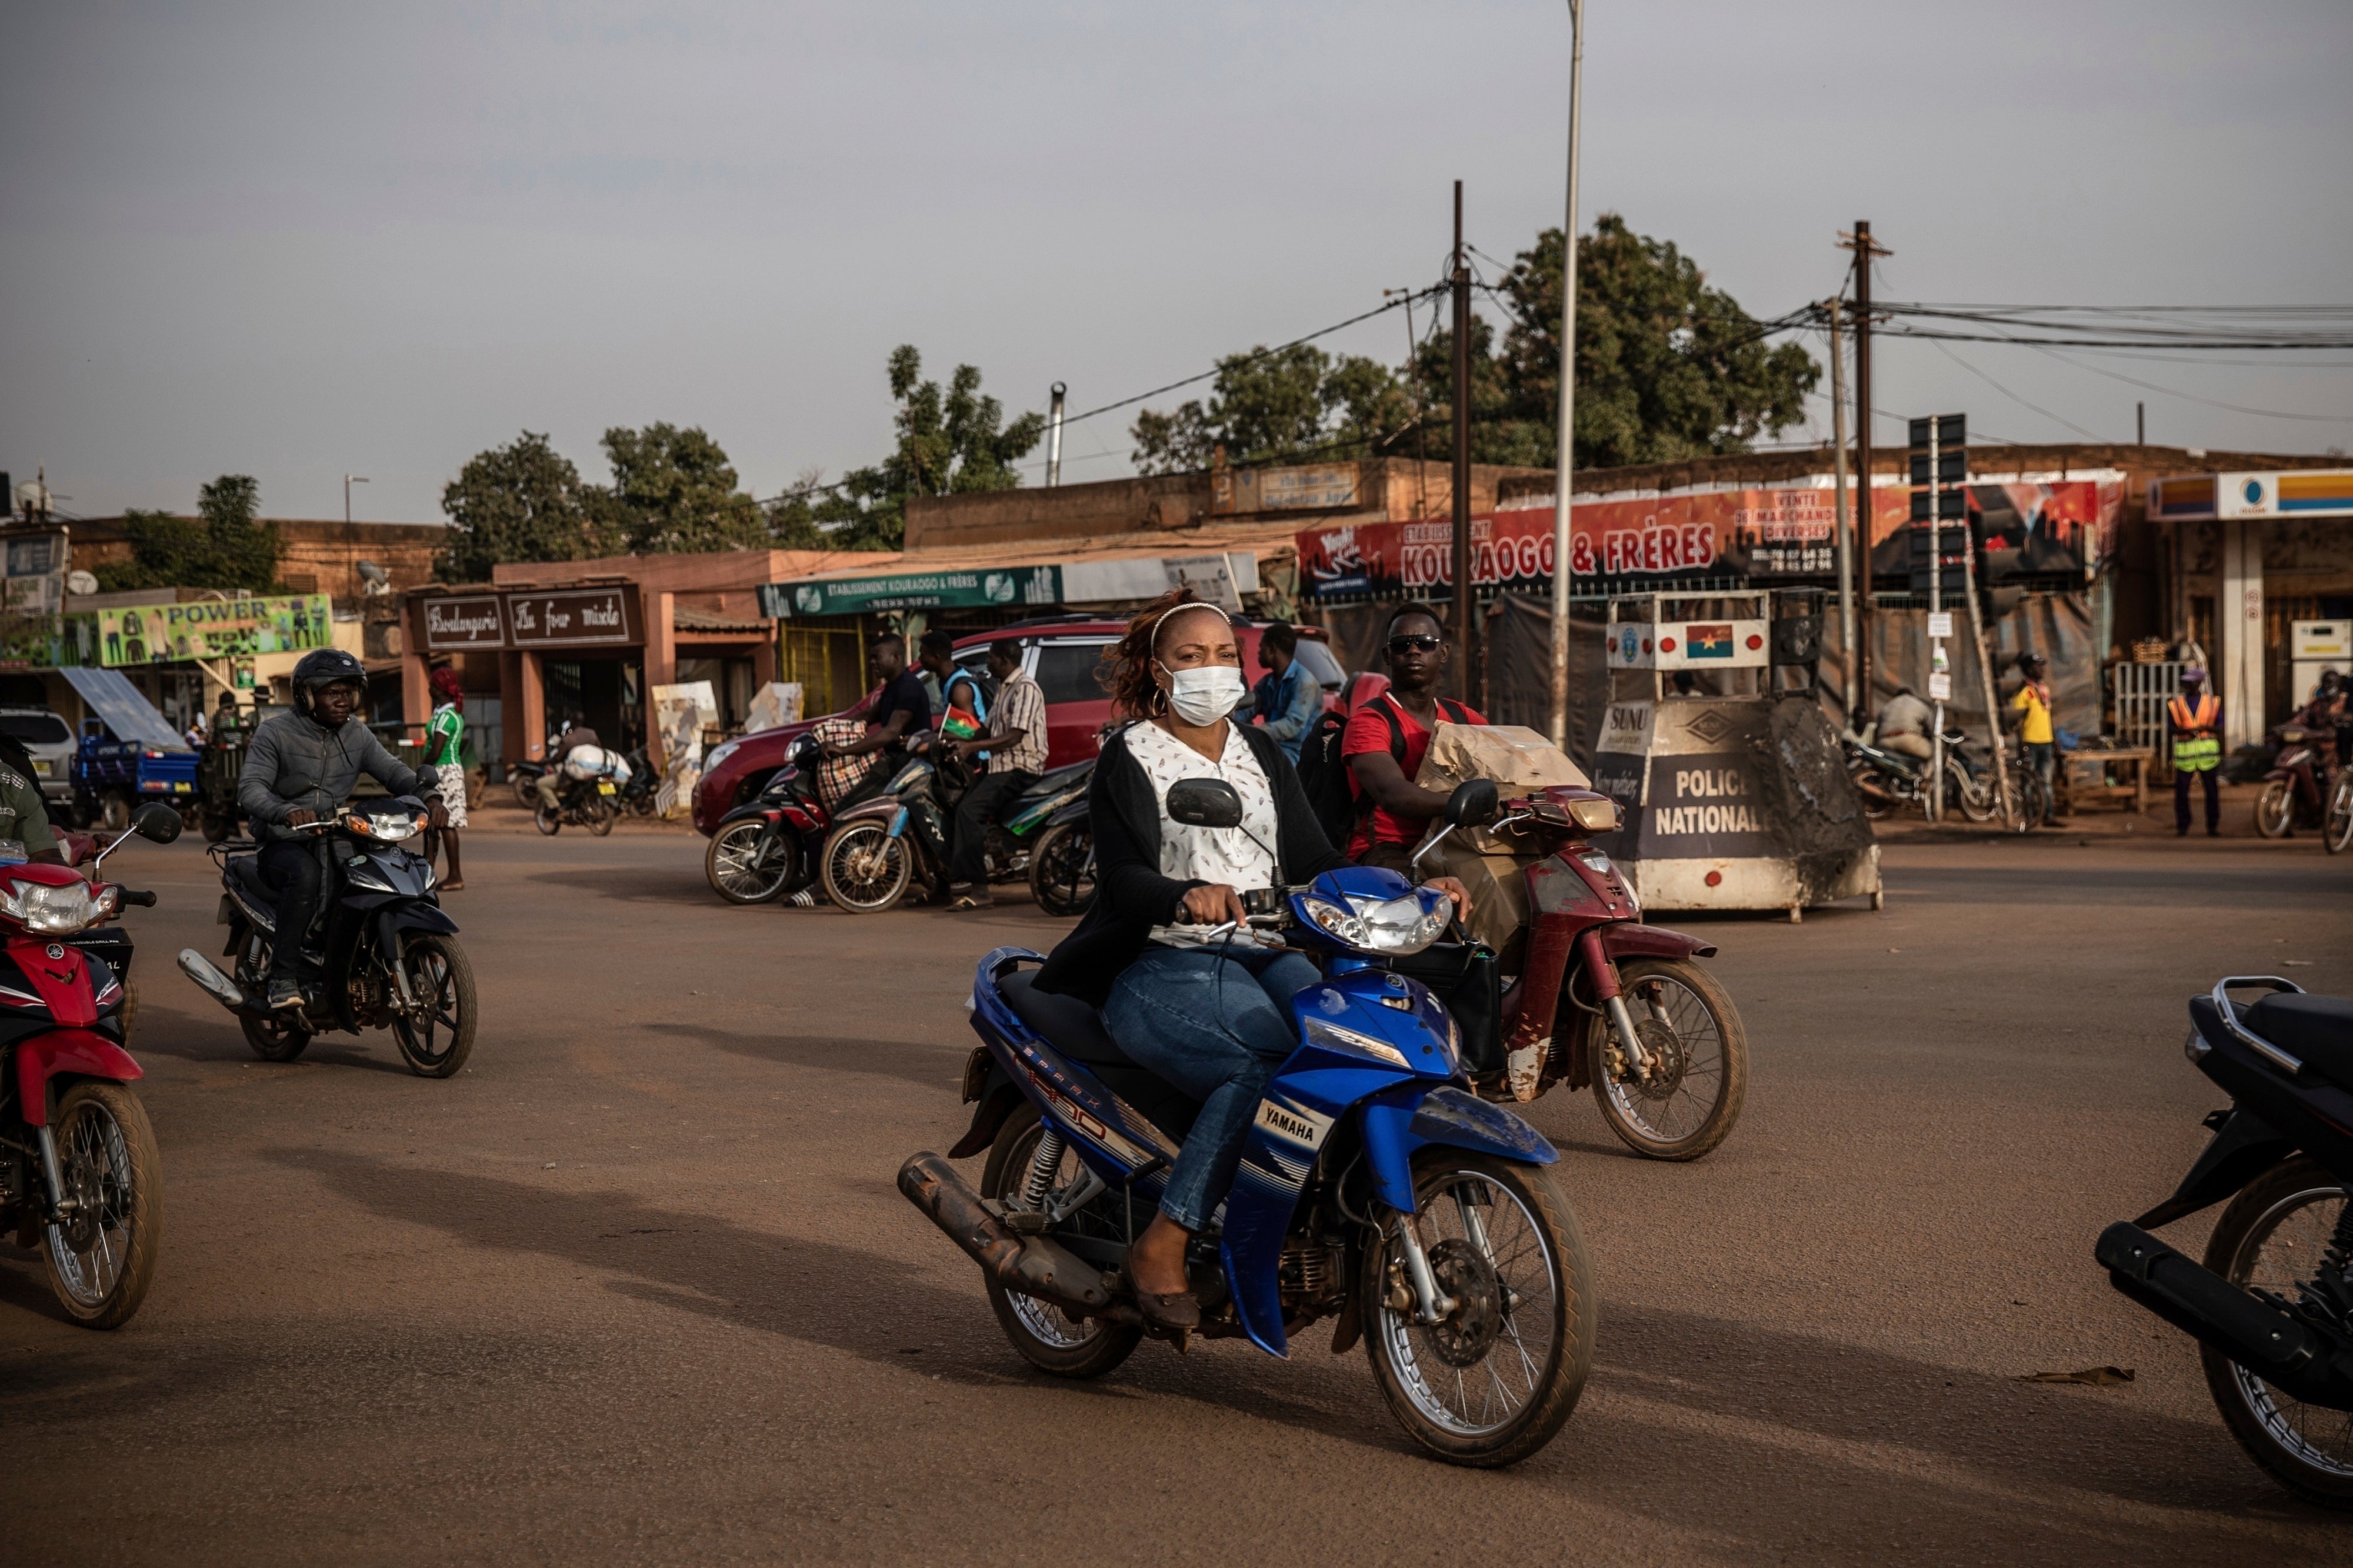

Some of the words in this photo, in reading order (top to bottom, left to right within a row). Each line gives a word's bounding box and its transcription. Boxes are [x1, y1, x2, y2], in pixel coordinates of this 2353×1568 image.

[1775, 492, 1819, 508] VENTE
[1765, 523, 1829, 540] DIVERSES
[1569, 531, 1597, 575] &
[168, 600, 270, 625] POWER
[429, 605, 499, 640] Boulangerie
[516, 600, 536, 630] Au
[544, 600, 571, 637] four
[581, 596, 619, 626] mixte
[1611, 708, 1648, 731] SUNU
[1655, 805, 1769, 835] NATIONAL
[1266, 1107, 1314, 1142] YAMAHA
